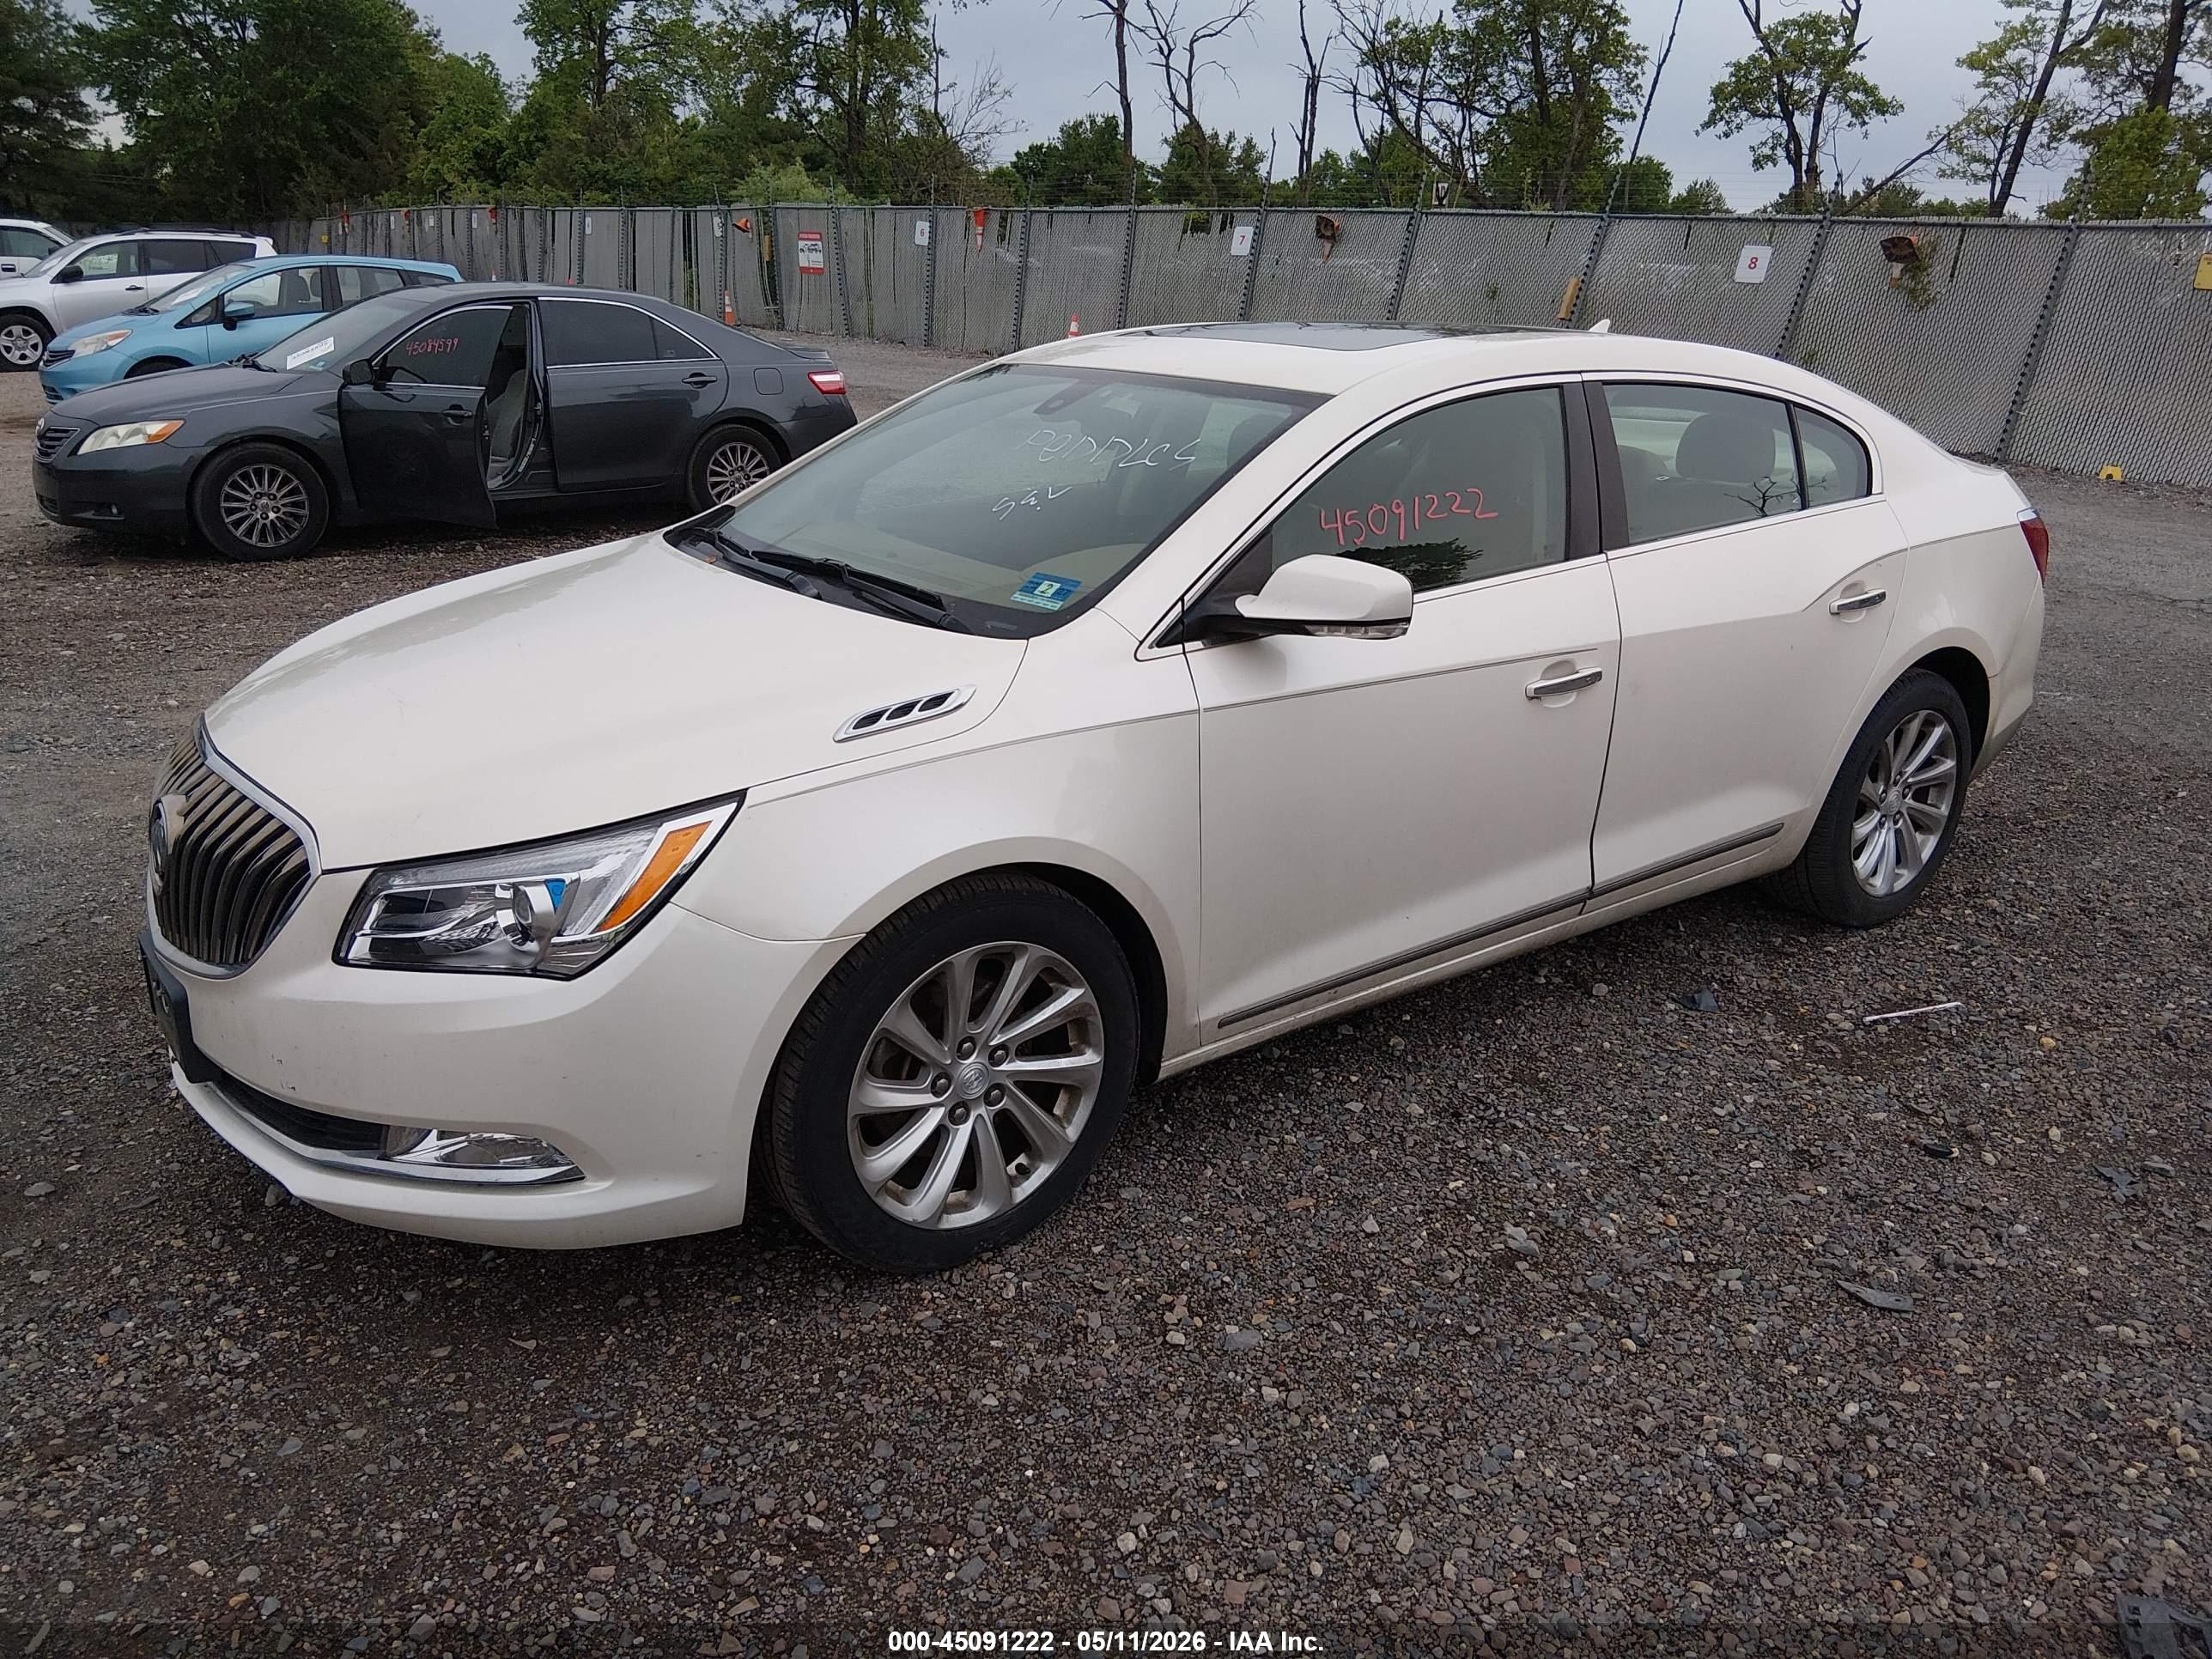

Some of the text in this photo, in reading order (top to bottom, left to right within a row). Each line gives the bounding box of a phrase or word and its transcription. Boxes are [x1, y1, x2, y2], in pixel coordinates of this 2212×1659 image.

[1239, 234, 1246, 246] 7
[1747, 256, 1759, 270] 8
[405, 337, 459, 356] 45084599
[1320, 487, 1498, 546] 45091222
[1038, 583, 1054, 595] 2
